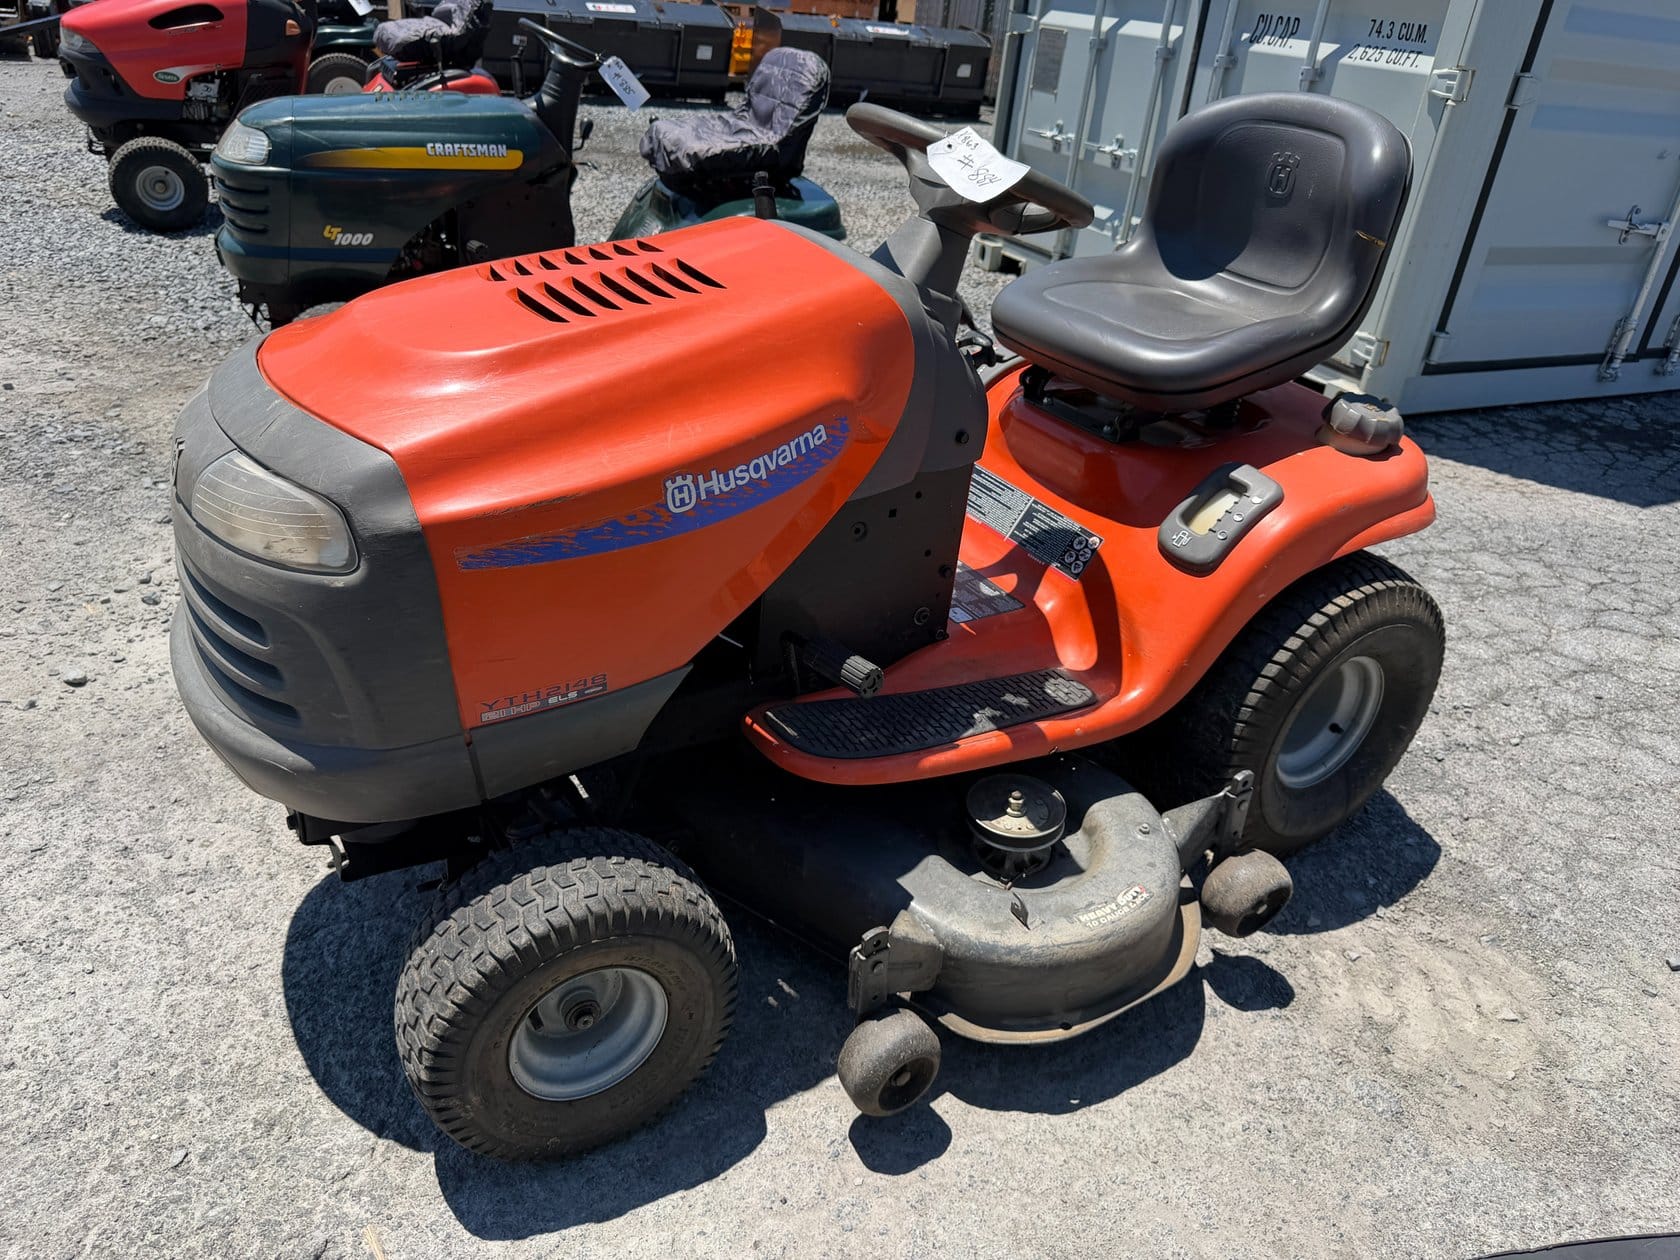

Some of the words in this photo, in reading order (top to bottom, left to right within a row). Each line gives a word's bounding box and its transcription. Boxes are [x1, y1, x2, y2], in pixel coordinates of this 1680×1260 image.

[1367, 18, 1395, 41] 74.3
[1397, 22, 1427, 44] CU.M.
[1347, 43, 1384, 63] 2,625
[1385, 47, 1424, 68] CU.FT.
[426, 142, 508, 158] CRAFTSMAN
[334, 232, 375, 246] 1000
[697, 424, 829, 501] Husqvarna
[481, 673, 607, 711] YTH2148
